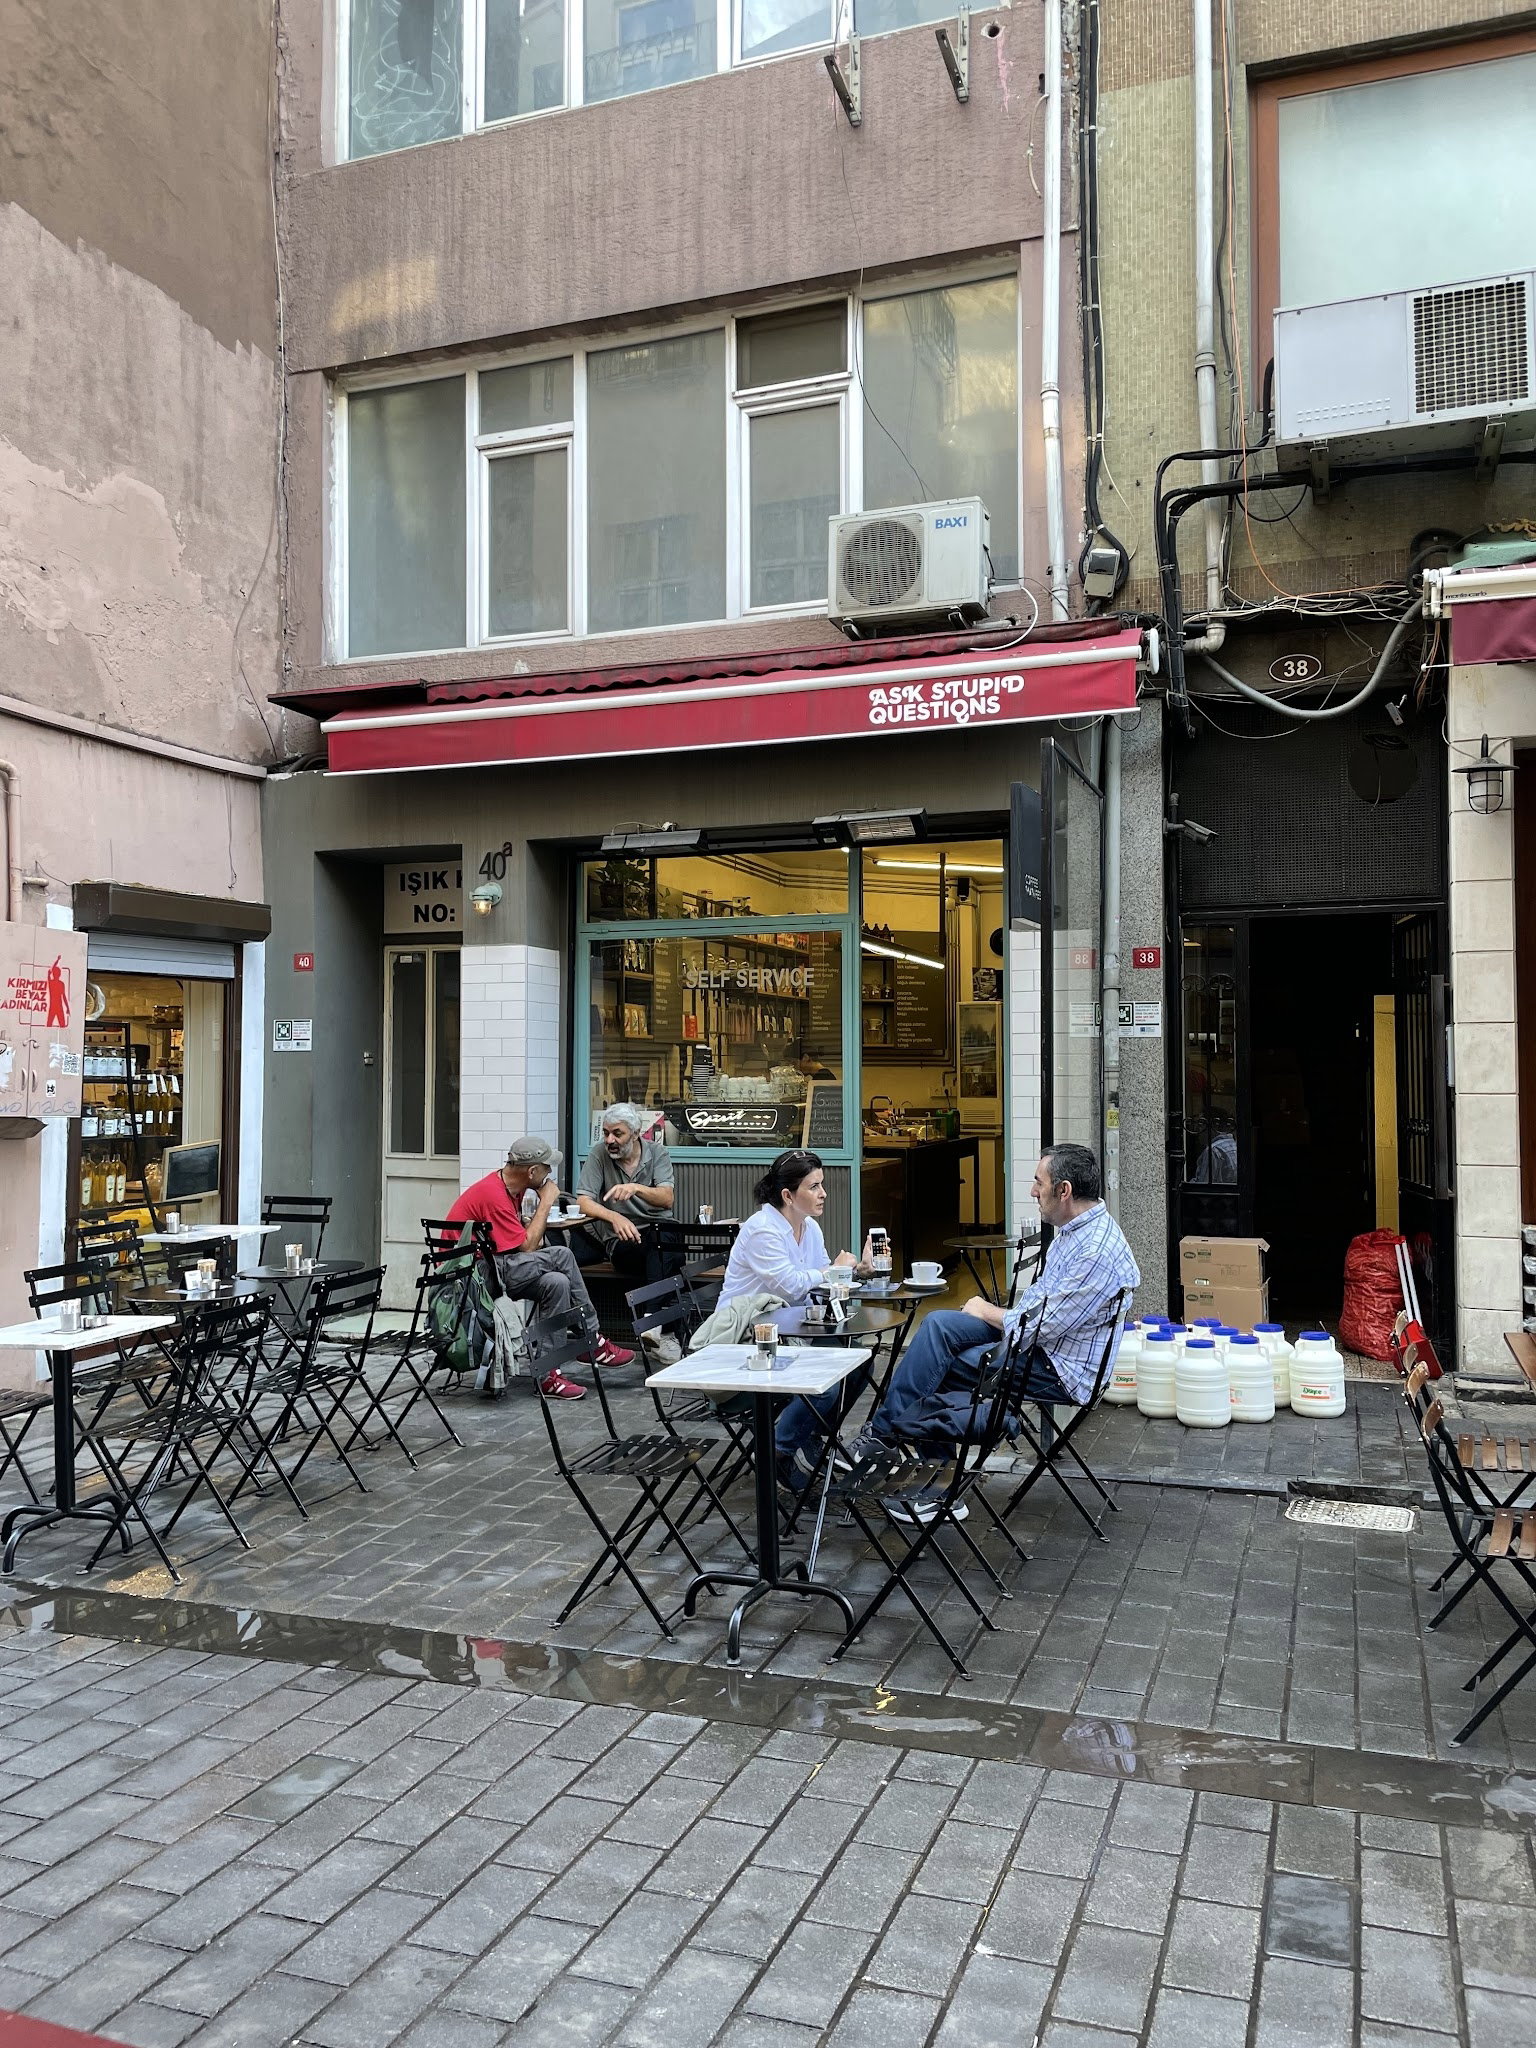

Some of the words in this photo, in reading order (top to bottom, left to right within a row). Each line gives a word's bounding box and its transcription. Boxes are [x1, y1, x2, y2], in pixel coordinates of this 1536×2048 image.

[935, 516, 968, 530] BAXI
[1283, 659, 1309, 678] 38
[868, 684, 924, 707] ASK
[930, 675, 1025, 700] STUPID
[868, 695, 1001, 725] QUESTIONS
[399, 869, 449, 896] IŞIK
[413, 903, 455, 924] NO:
[298, 956, 310, 968] 40
[1139, 952, 1155, 964] 38
[7, 977, 48, 991] KIRMIZI
[685, 969, 732, 990] SELF
[735, 967, 815, 989] SERVICE
[15, 989, 47, 1002] BEYAZ
[0, 999, 48, 1013] ADINLAR
[689, 1109, 746, 1127] Spirit
